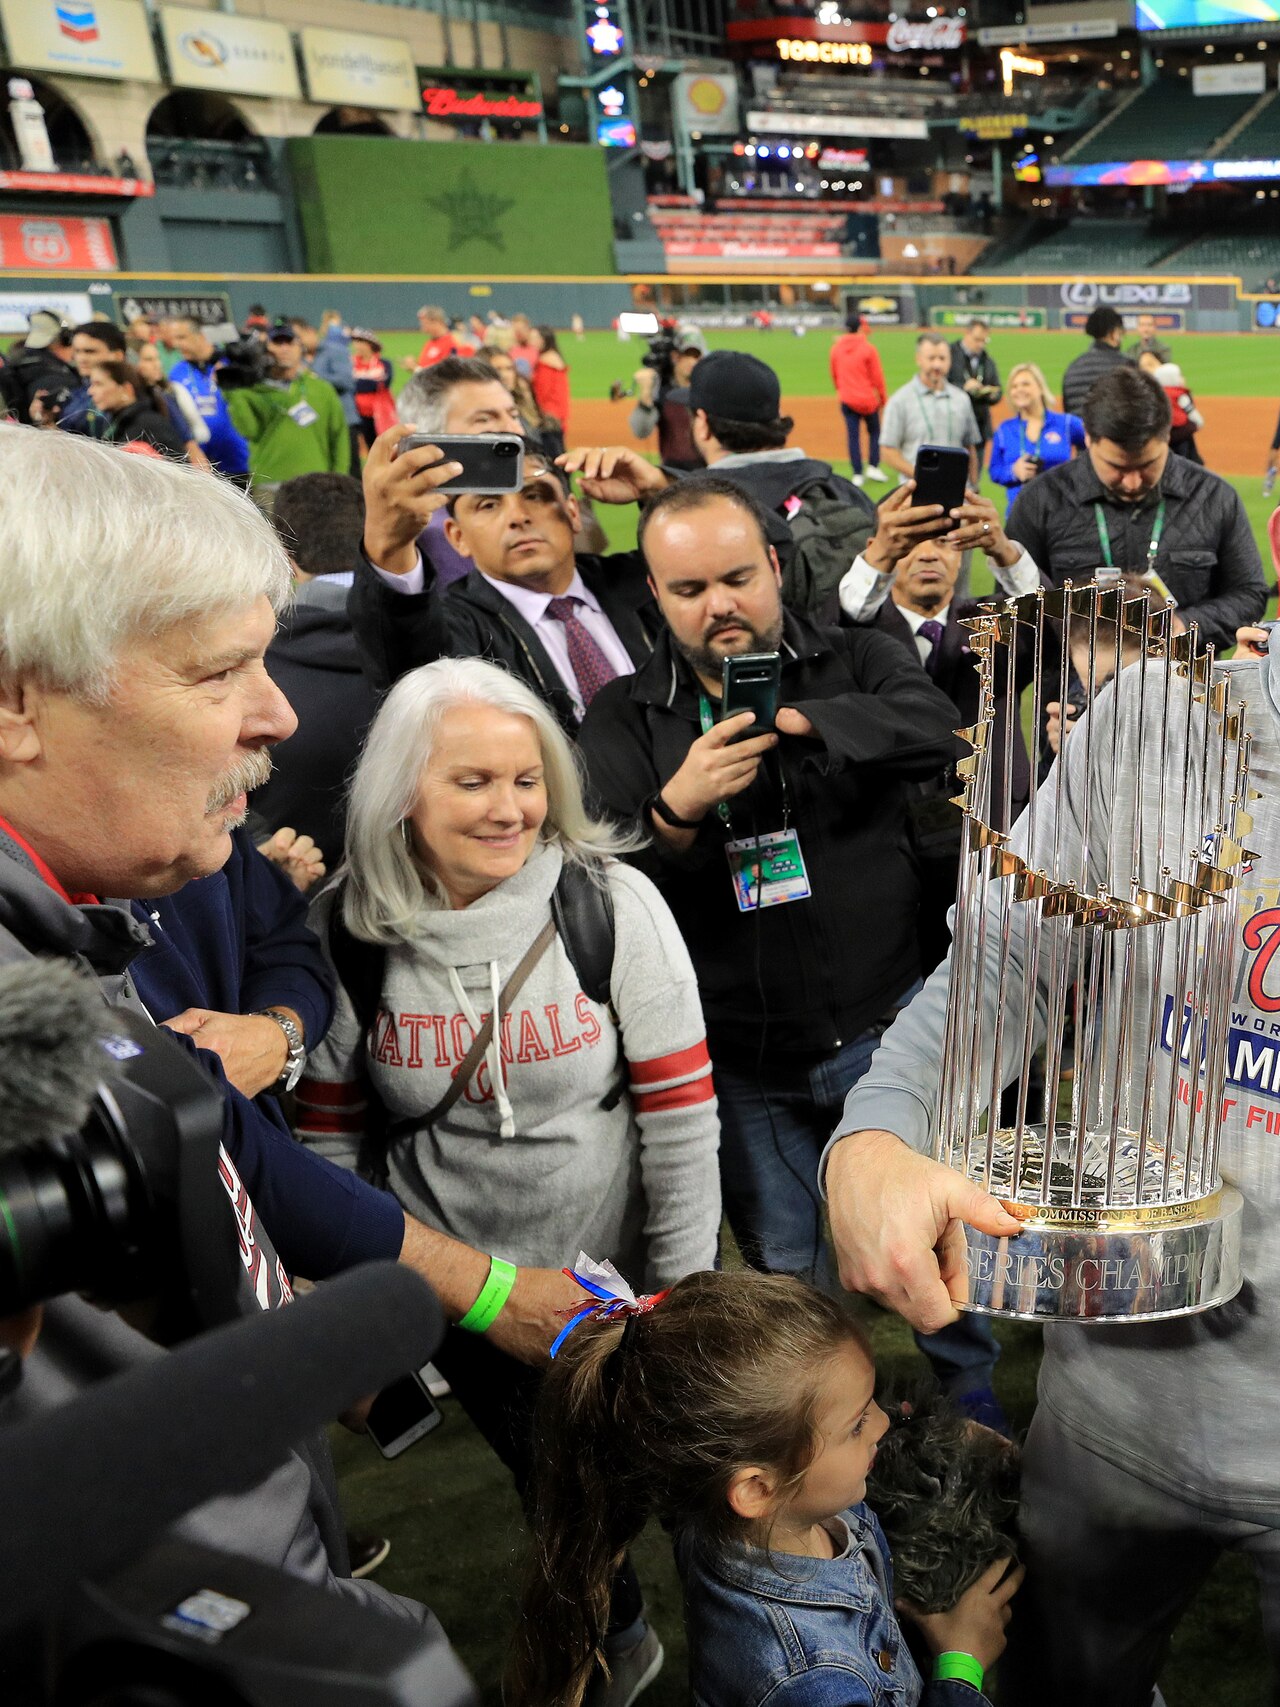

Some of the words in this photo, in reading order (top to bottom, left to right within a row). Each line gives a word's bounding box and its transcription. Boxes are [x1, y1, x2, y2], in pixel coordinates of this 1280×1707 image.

[1028, 1207, 1138, 1222] COMMISSIONER
[1143, 1209, 1158, 1220] OF
[960, 1245, 1065, 1289] SERIES
